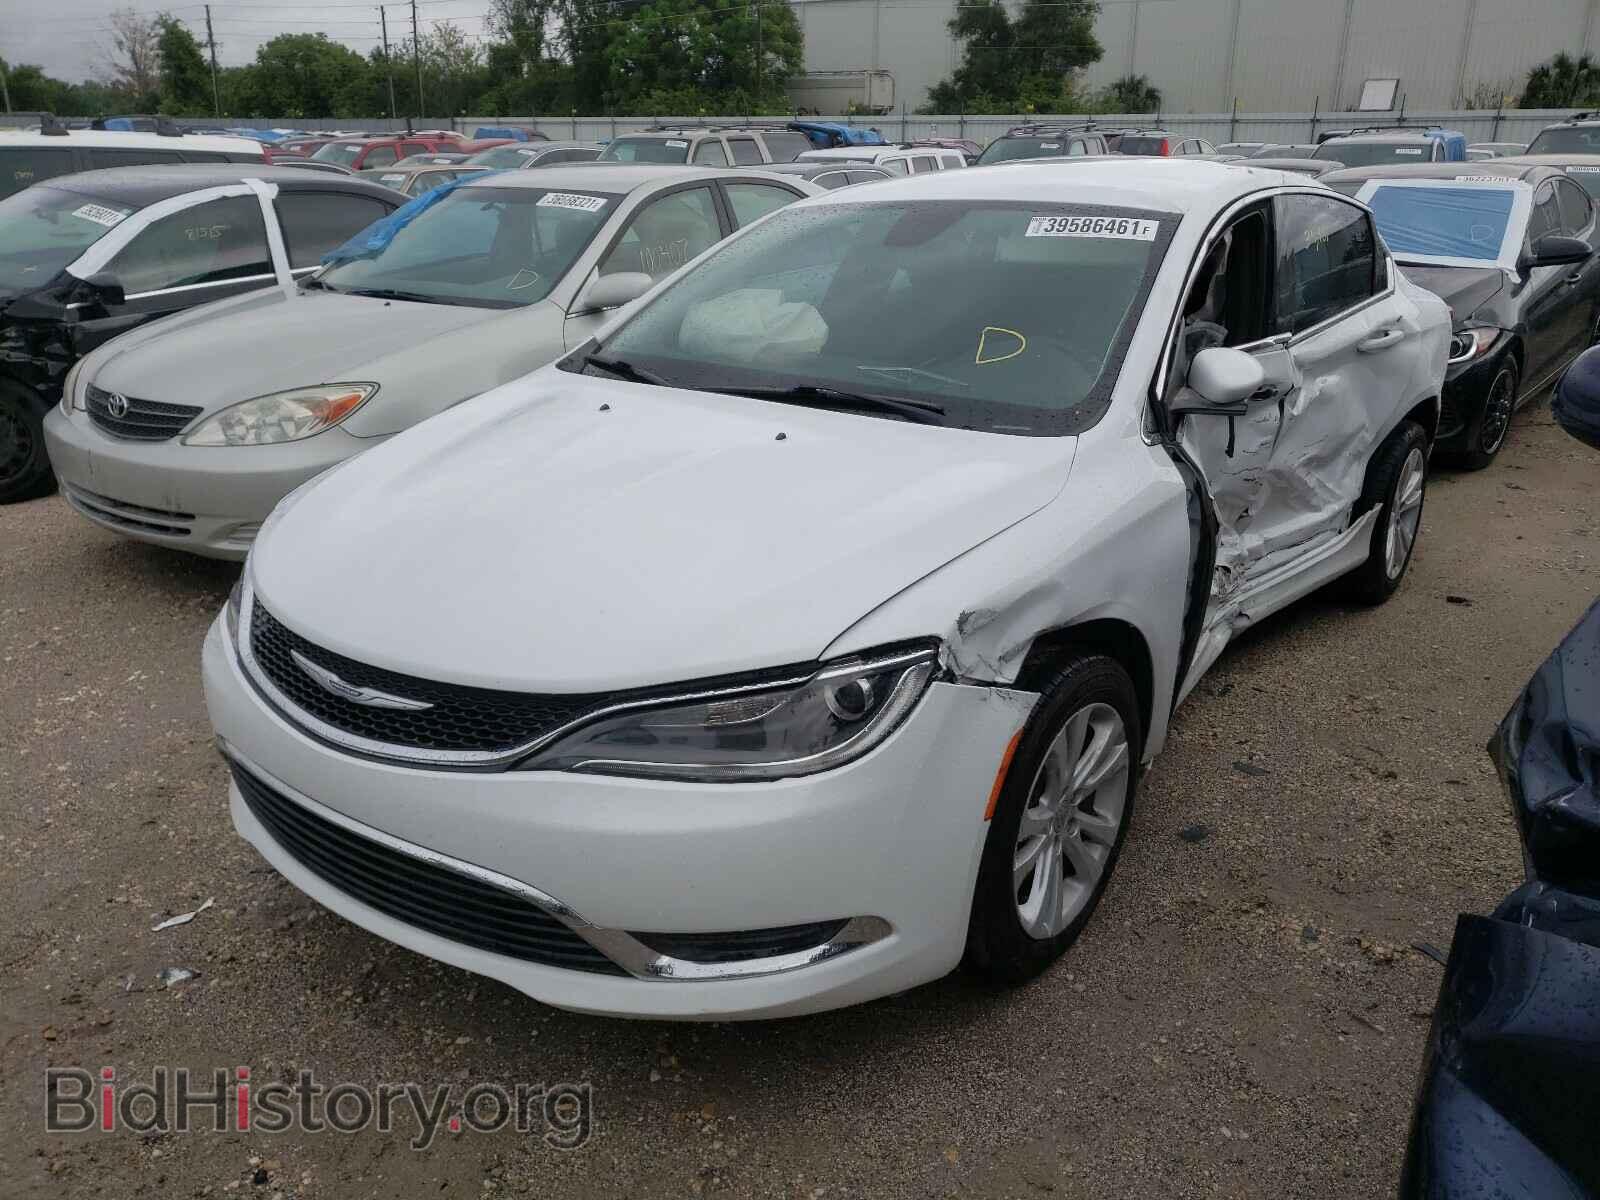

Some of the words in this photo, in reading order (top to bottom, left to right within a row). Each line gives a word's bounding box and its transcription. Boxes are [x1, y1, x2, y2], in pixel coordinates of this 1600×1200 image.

[1043, 217, 1141, 236] 39586461
[1142, 226, 1151, 235] F
[975, 326, 1027, 364] D
